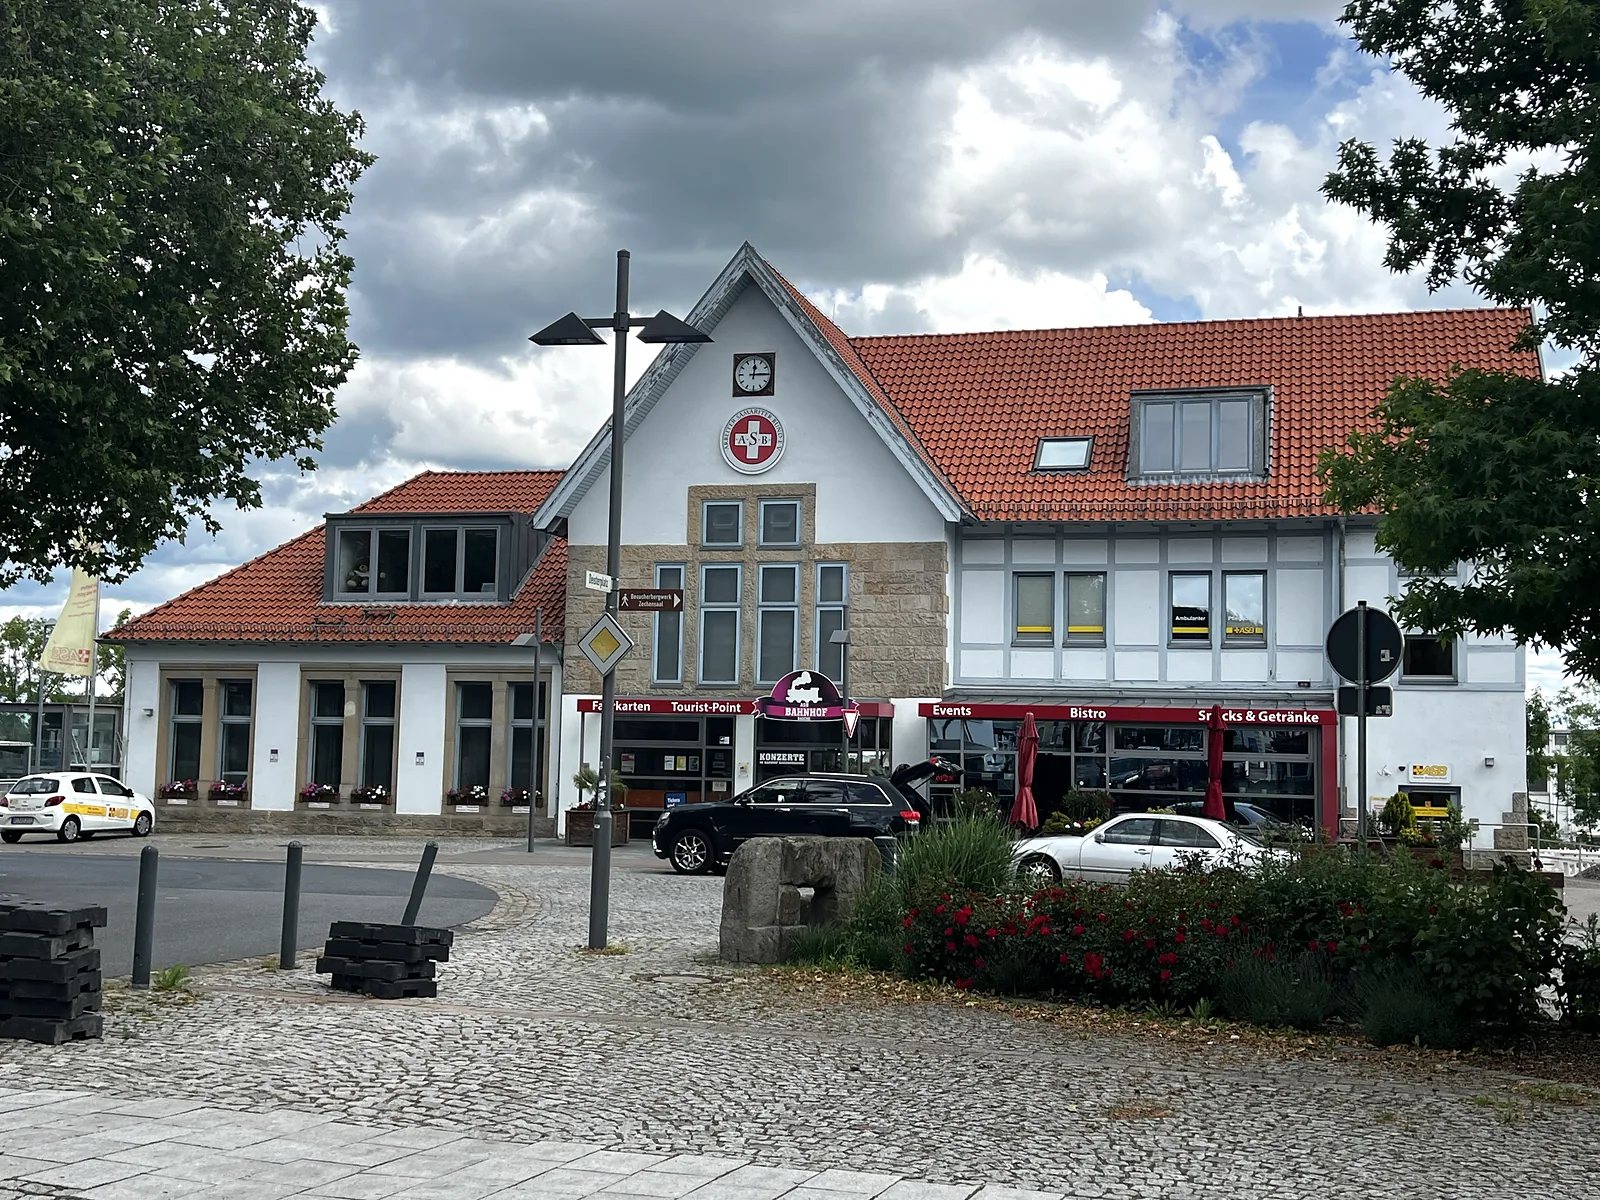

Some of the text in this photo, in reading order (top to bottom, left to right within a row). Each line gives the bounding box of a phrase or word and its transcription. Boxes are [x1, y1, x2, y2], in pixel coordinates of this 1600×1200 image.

[589, 573, 608, 588] Deisterplatz
[630, 593, 672, 601] Besucherbergwerk
[1238, 626, 1255, 634] ASB
[592, 701, 741, 713] Fakarten Tourist-Point
[785, 707, 828, 716] BAHNHOF
[933, 705, 1319, 723] Events Bistro Sncks & Getränke
[759, 752, 805, 761] KONZERTE
[1421, 765, 1448, 776] ASB
